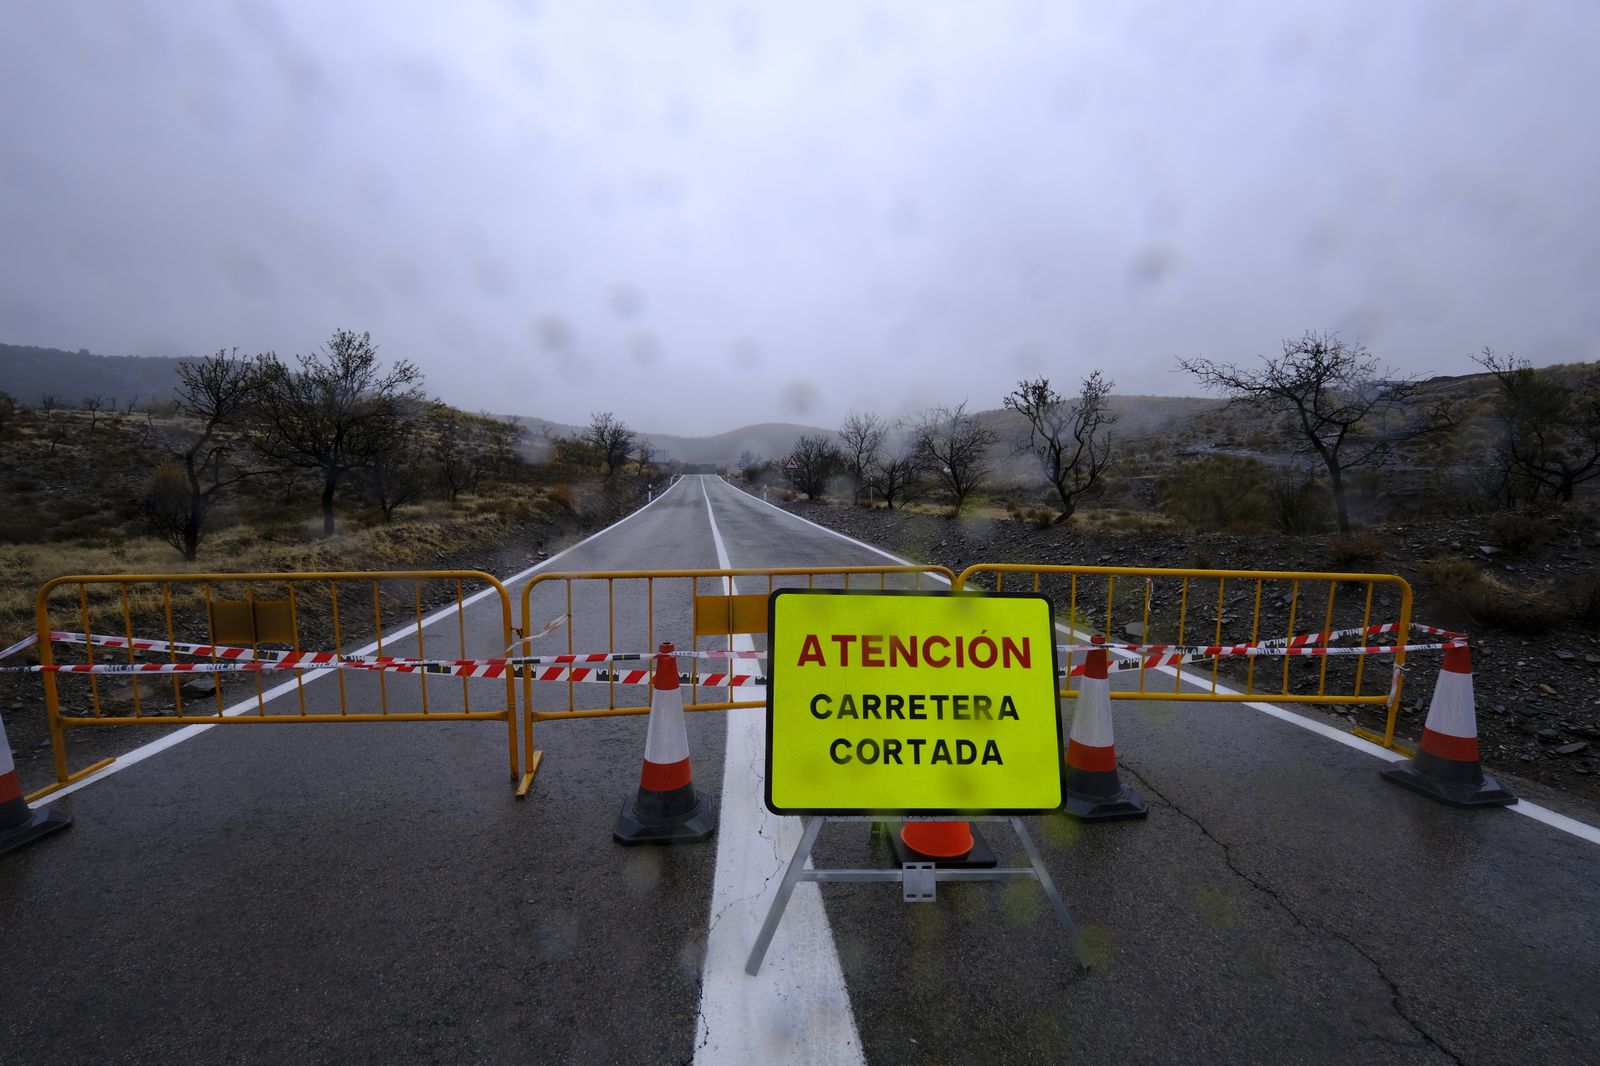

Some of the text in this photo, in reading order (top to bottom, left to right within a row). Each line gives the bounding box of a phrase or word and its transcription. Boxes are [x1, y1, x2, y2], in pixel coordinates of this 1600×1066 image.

[797, 629, 1032, 669] ATENCIÓN
[1174, 646, 1198, 655] NILA
[810, 693, 1020, 720] CARRETERA
[829, 738, 1004, 766] CORTADA
